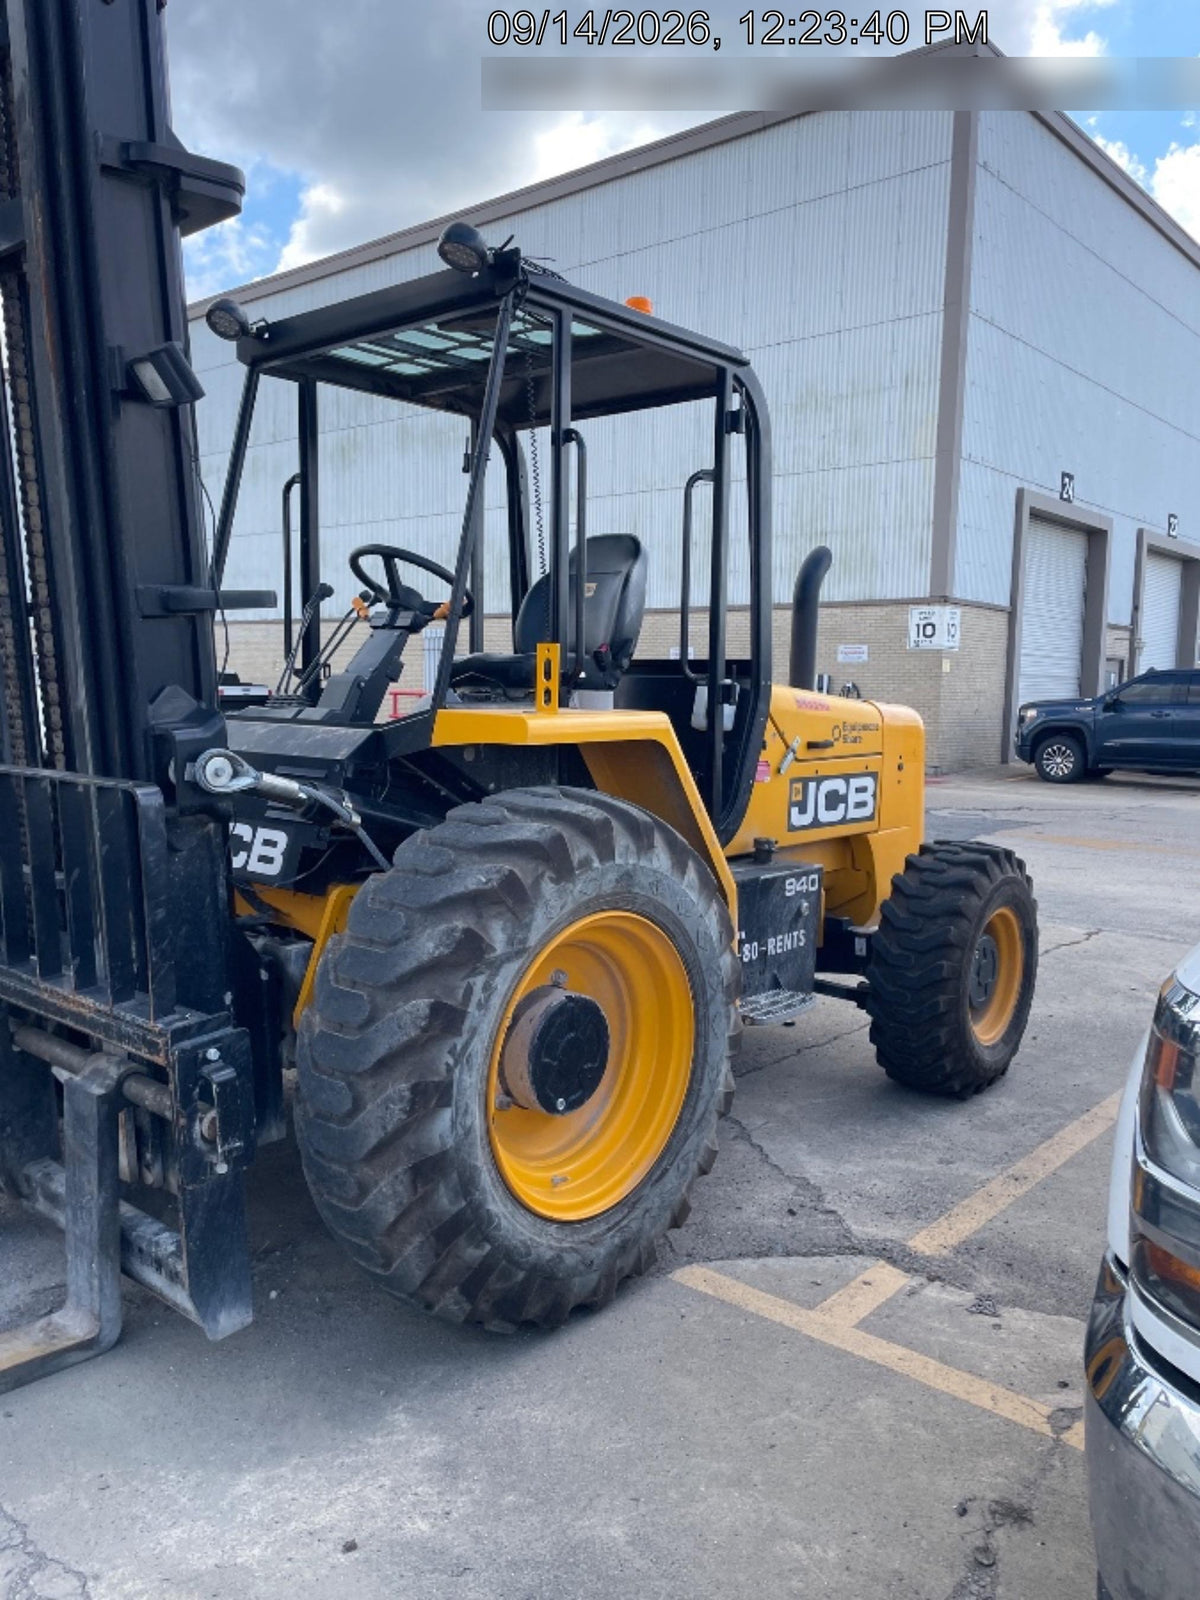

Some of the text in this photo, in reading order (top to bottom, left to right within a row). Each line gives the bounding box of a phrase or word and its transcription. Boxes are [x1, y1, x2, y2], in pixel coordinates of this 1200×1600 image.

[915, 622, 936, 639] 10
[790, 776, 876, 827] JCB
[228, 822, 288, 875] CB
[785, 874, 819, 897] 940
